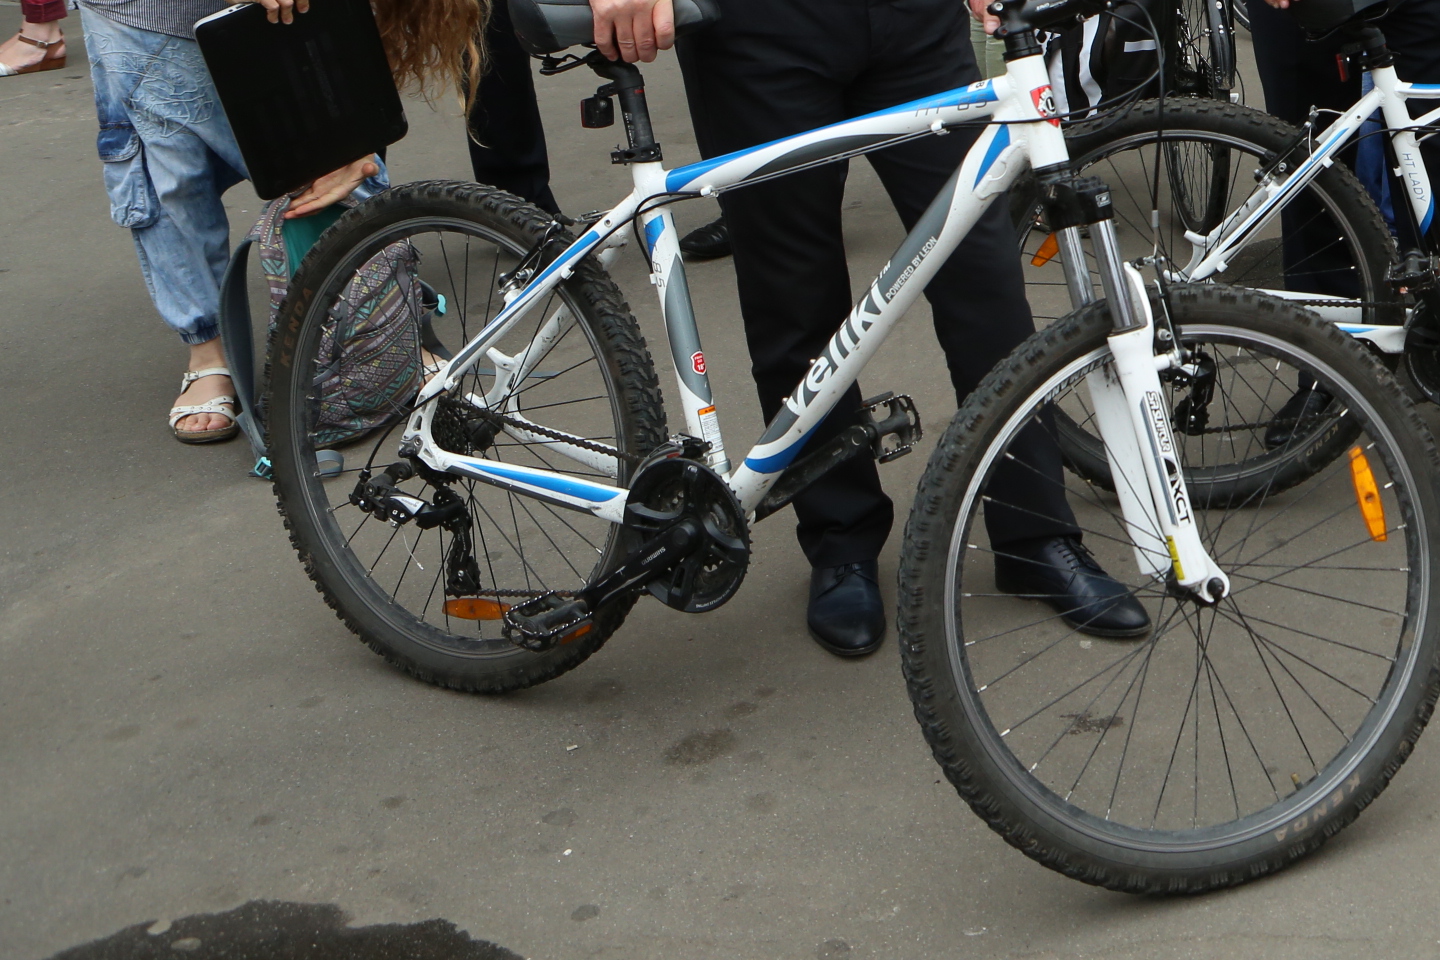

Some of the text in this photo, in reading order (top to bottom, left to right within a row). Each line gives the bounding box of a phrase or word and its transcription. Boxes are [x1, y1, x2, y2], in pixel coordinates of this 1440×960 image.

[1402, 152, 1426, 202] HT LADY
[885, 236, 937, 301] POWERED BY LEON
[279, 287, 314, 368] KENDA
[1173, 483, 1191, 525] XCT
[1273, 772, 1361, 842] KENDA
